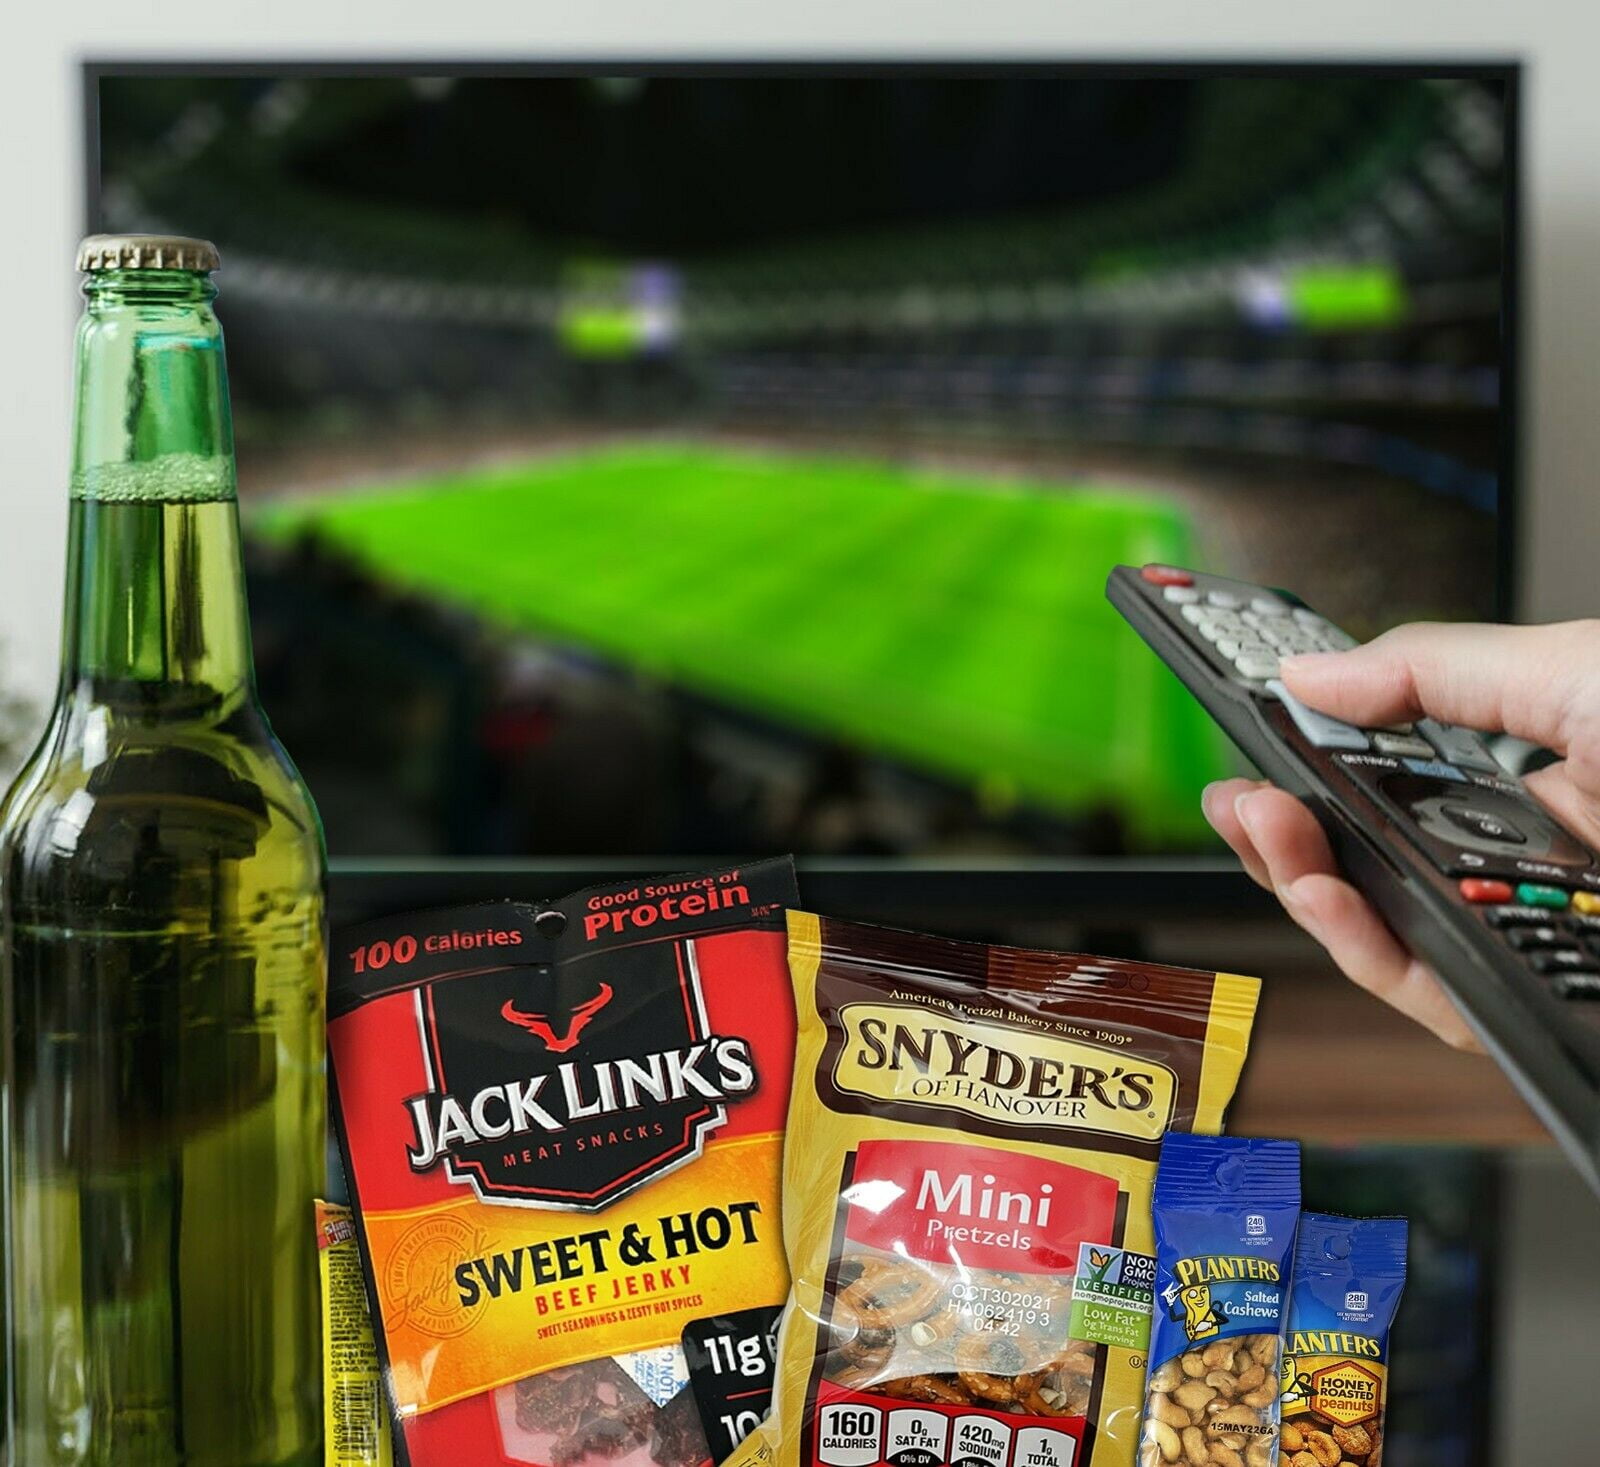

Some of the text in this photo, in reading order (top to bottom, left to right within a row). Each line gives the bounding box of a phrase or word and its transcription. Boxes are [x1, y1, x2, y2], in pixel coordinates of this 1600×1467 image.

[588, 870, 740, 910] Good Source of
[583, 885, 750, 941] Protein
[350, 929, 523, 973] 100 Calories
[889, 989, 954, 1010] America's
[958, 1002, 1004, 1019] Pretzel
[1008, 1011, 1052, 1031] Bakery
[1055, 1022, 1090, 1037] Since
[857, 1017, 1154, 1112] SNYDER'S
[409, 1039, 755, 1166] JACK LINK'S
[912, 1078, 1088, 1119] OF HANOVER
[503, 1123, 664, 1167] MEAT SNACKS
[915, 1169, 1053, 1227] Mini
[1248, 1217, 1263, 1226] 240
[926, 1219, 1032, 1250] Pretzels
[454, 1201, 762, 1307] SWEET & HOT
[1126, 1254, 1157, 1270] NON
[1176, 1257, 1280, 1287] PLANTERS
[535, 1264, 692, 1316] BEEF JERKY
[952, 1283, 1051, 1311] OCT302021
[1081, 1279, 1152, 1303] VERIFIED
[1244, 1290, 1279, 1304] Salted
[1348, 1294, 1365, 1302] 280
[1074, 1291, 1153, 1313] nongmoproject.org
[1083, 1305, 1112, 1322] Low
[1224, 1301, 1279, 1318] Cashews
[537, 1324, 563, 1340] SWEET
[562, 1311, 619, 1333] SEASONINGS
[627, 1305, 652, 1319] ZESTY
[654, 1301, 671, 1315] HOT
[671, 1294, 703, 1311] SPICES
[974, 1318, 1020, 1337] 04:42
[1086, 1330, 1135, 1347] per serving
[1099, 1321, 1123, 1334] Trans
[1125, 1326, 1139, 1337] Fat
[703, 1335, 766, 1376] 11g
[1282, 1332, 1381, 1357] LANTERS
[1320, 1377, 1375, 1391] HONEY
[1320, 1388, 1374, 1400] ROASTED
[1320, 1399, 1373, 1412] peanuts
[828, 1411, 875, 1436] 160
[1211, 1423, 1274, 1436] 15MAY22GA
[822, 1437, 877, 1449] CALORIES
[895, 1435, 940, 1448] SAT FAT
[958, 1441, 1002, 1460] SODIUM
[900, 1454, 931, 1464] 0% DV
[1027, 1453, 1059, 1467] TOTAL
